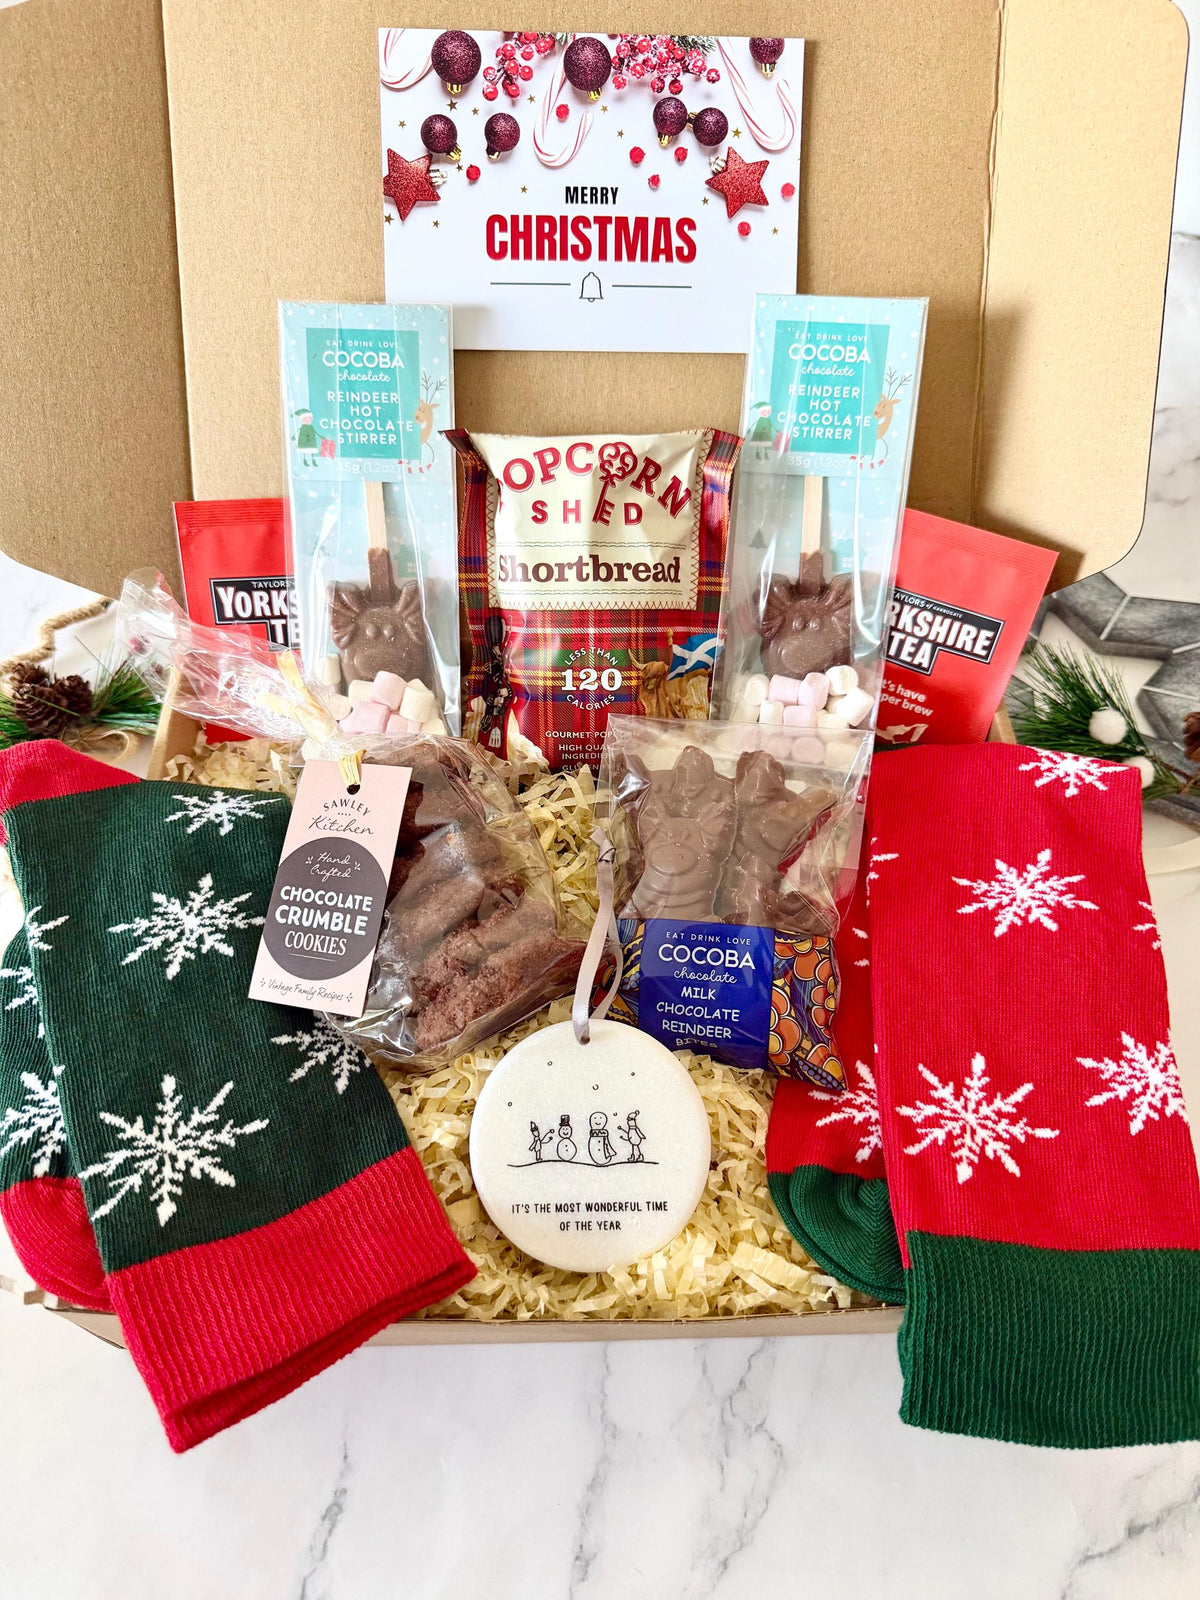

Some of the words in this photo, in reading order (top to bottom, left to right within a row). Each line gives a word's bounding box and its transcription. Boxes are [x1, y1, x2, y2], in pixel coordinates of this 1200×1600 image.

[565, 186, 619, 205] MERRY
[486, 214, 697, 264] CHRISTMAS
[795, 333, 811, 341] EAT
[816, 334, 842, 342] DRINK
[847, 335, 868, 343] LOVE
[322, 350, 405, 369] COCOBA
[788, 343, 871, 364] COCOBA
[337, 370, 391, 383] chocolate
[800, 363, 856, 377] chocolate
[327, 390, 399, 404] REINDEER
[788, 384, 861, 399] REINDEER
[350, 406, 382, 417] HOT
[809, 400, 842, 412] HOT
[319, 418, 414, 432] CHOCOLATE
[777, 412, 872, 427] CHOCOLATE
[338, 433, 397, 445] STIRRER
[792, 426, 853, 440] STIRRER
[496, 441, 692, 519] OPCORN
[531, 499, 643, 527] SHED
[498, 554, 681, 584] Shortbread
[251, 580, 290, 588] TAYLORS
[893, 591, 926, 608] AYLORS
[564, 647, 587, 666] LESS
[590, 646, 618, 666] THAN
[888, 631, 934, 669] TEA
[561, 668, 622, 691] 120
[566, 694, 615, 711] CALORIES
[896, 684, 926, 703] have
[901, 699, 935, 717] brew
[545, 730, 591, 739] GOURMET
[558, 744, 582, 752] HIGH
[323, 797, 371, 817] SAWLEY
[308, 815, 374, 836] Kitchen
[317, 851, 351, 865] Hand
[310, 863, 352, 883] Crafted
[280, 885, 374, 912] CHOCOLATE
[275, 904, 369, 936] CRUMBLE
[285, 930, 348, 956] COOKIES
[666, 931, 685, 940] EAT
[691, 933, 721, 943] DRINK
[726, 936, 752, 946] LOVE
[658, 943, 756, 970] COCOBA
[673, 966, 738, 984] chocolate
[268, 979, 293, 996] Vintage
[293, 984, 317, 1000] Family
[317, 987, 344, 1002] Recipes
[680, 986, 716, 1000] MILK
[656, 1001, 740, 1022] CHOCOLATE
[662, 1019, 732, 1039] REINDEER
[675, 1037, 718, 1048] BITES
[511, 1203, 530, 1214] IT'S
[534, 1203, 551, 1213] THE
[555, 1202, 581, 1213] MOST
[585, 1201, 643, 1213] WONDERFUL
[646, 1201, 668, 1211] TIME
[559, 1221, 571, 1232] OF
[574, 1220, 593, 1231] THE
[597, 1220, 622, 1231] YEAR
